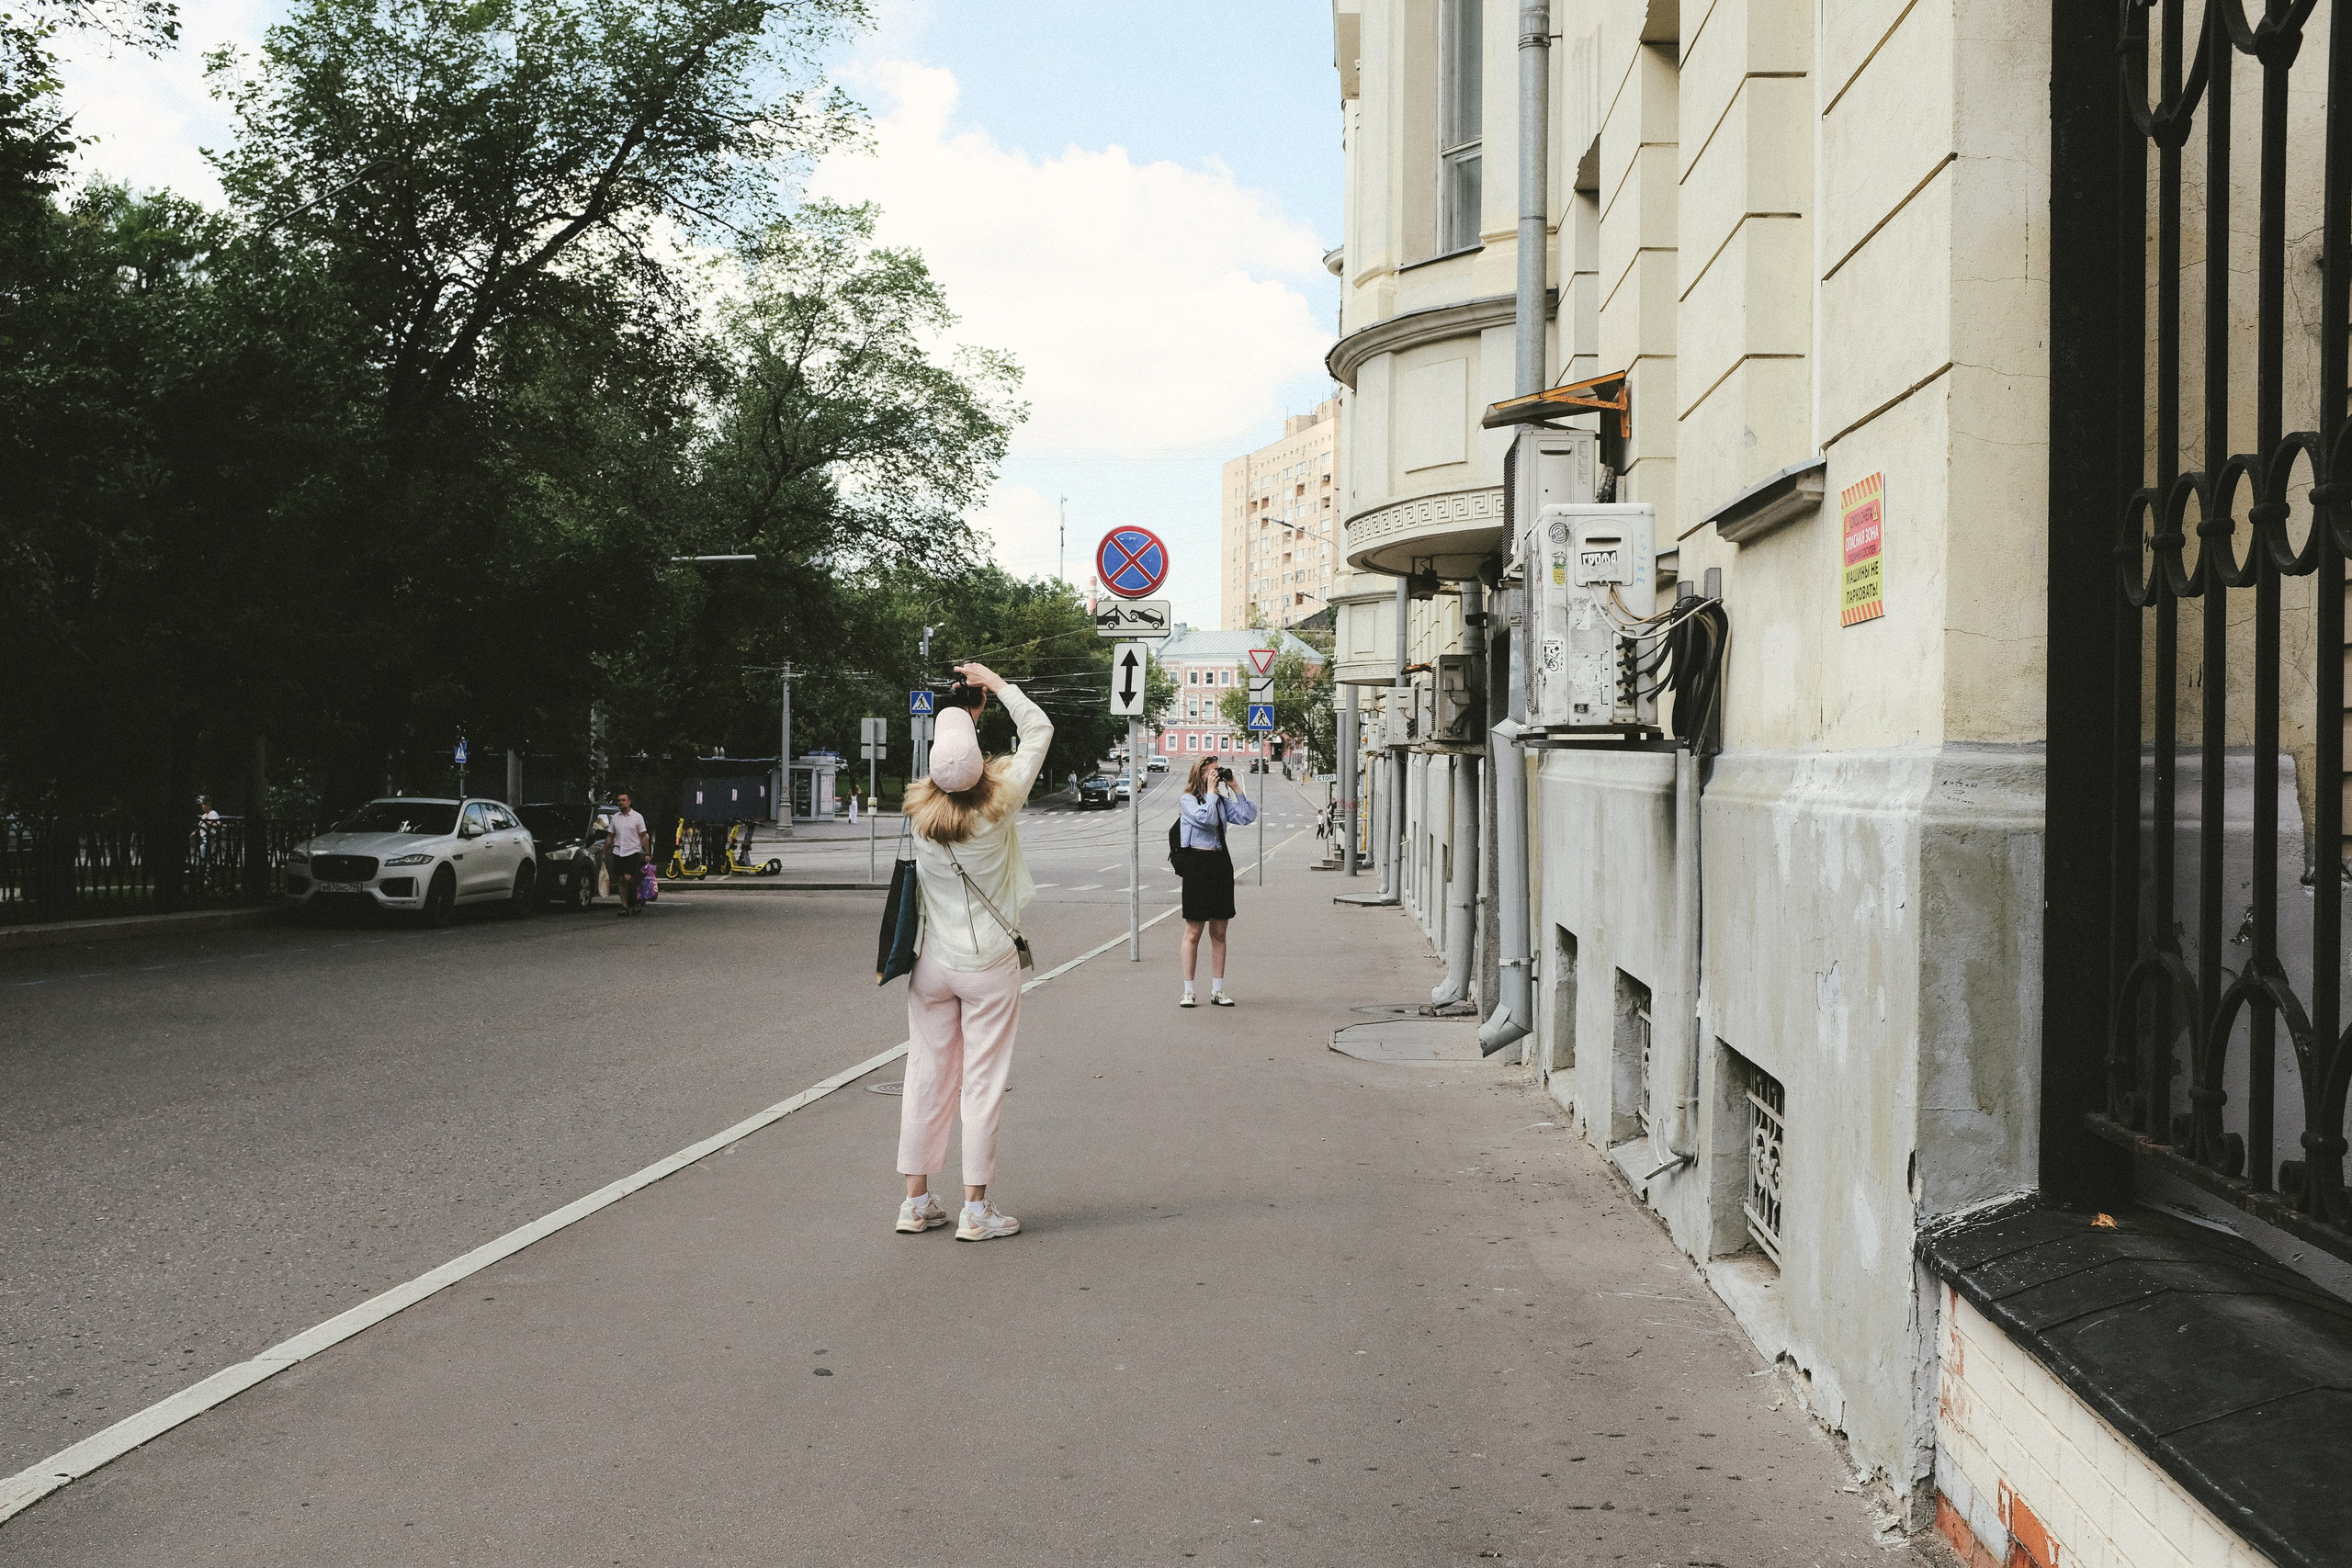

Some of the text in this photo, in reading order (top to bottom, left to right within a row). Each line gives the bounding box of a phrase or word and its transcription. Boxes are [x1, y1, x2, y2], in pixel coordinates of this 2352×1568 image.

[1845, 525, 1879, 551] ОПАСНАЯ ЗОНА
[1846, 561, 1878, 584] МАШИНЫ НЕ
[1846, 581, 1878, 604] ПАРКОВАТЬ!
